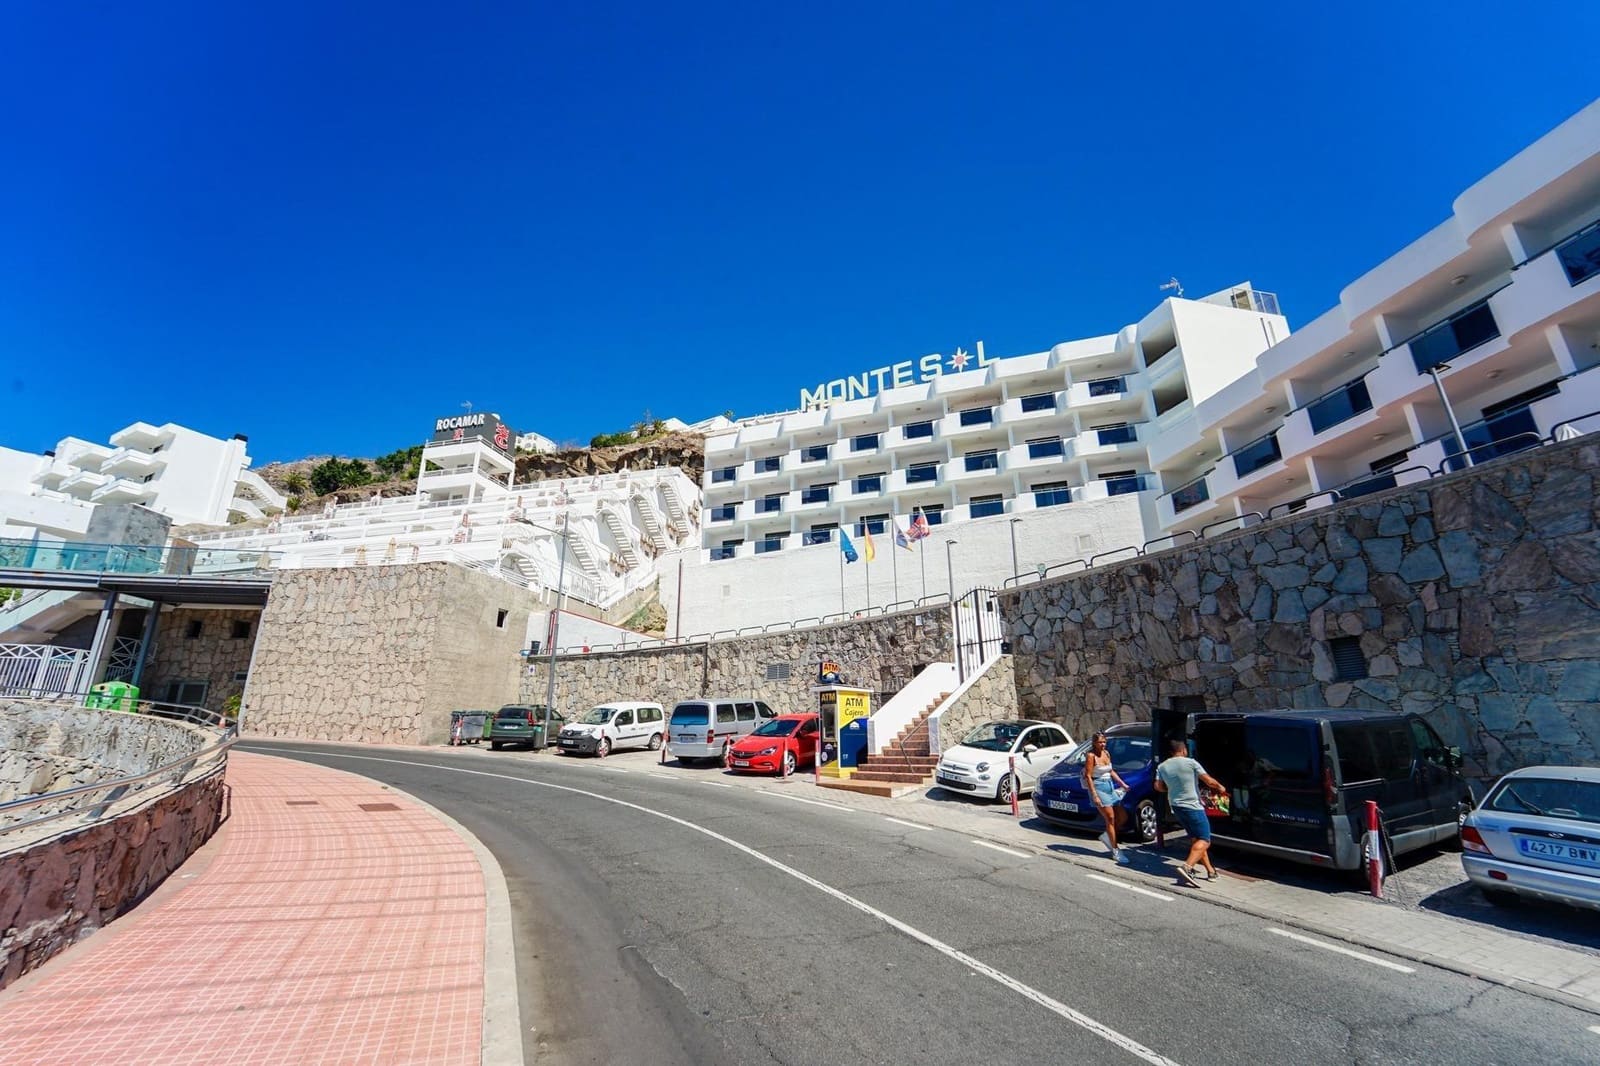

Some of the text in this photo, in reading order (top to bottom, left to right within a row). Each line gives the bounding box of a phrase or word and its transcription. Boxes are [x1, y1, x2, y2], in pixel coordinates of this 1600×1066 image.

[436, 414, 485, 430] ROCAMAR
[824, 663, 838, 671] ATM
[822, 693, 836, 702] ATM
[845, 698, 863, 707] ATM
[845, 708, 864, 718] Cajero
[1531, 842, 1563, 855] 4217
